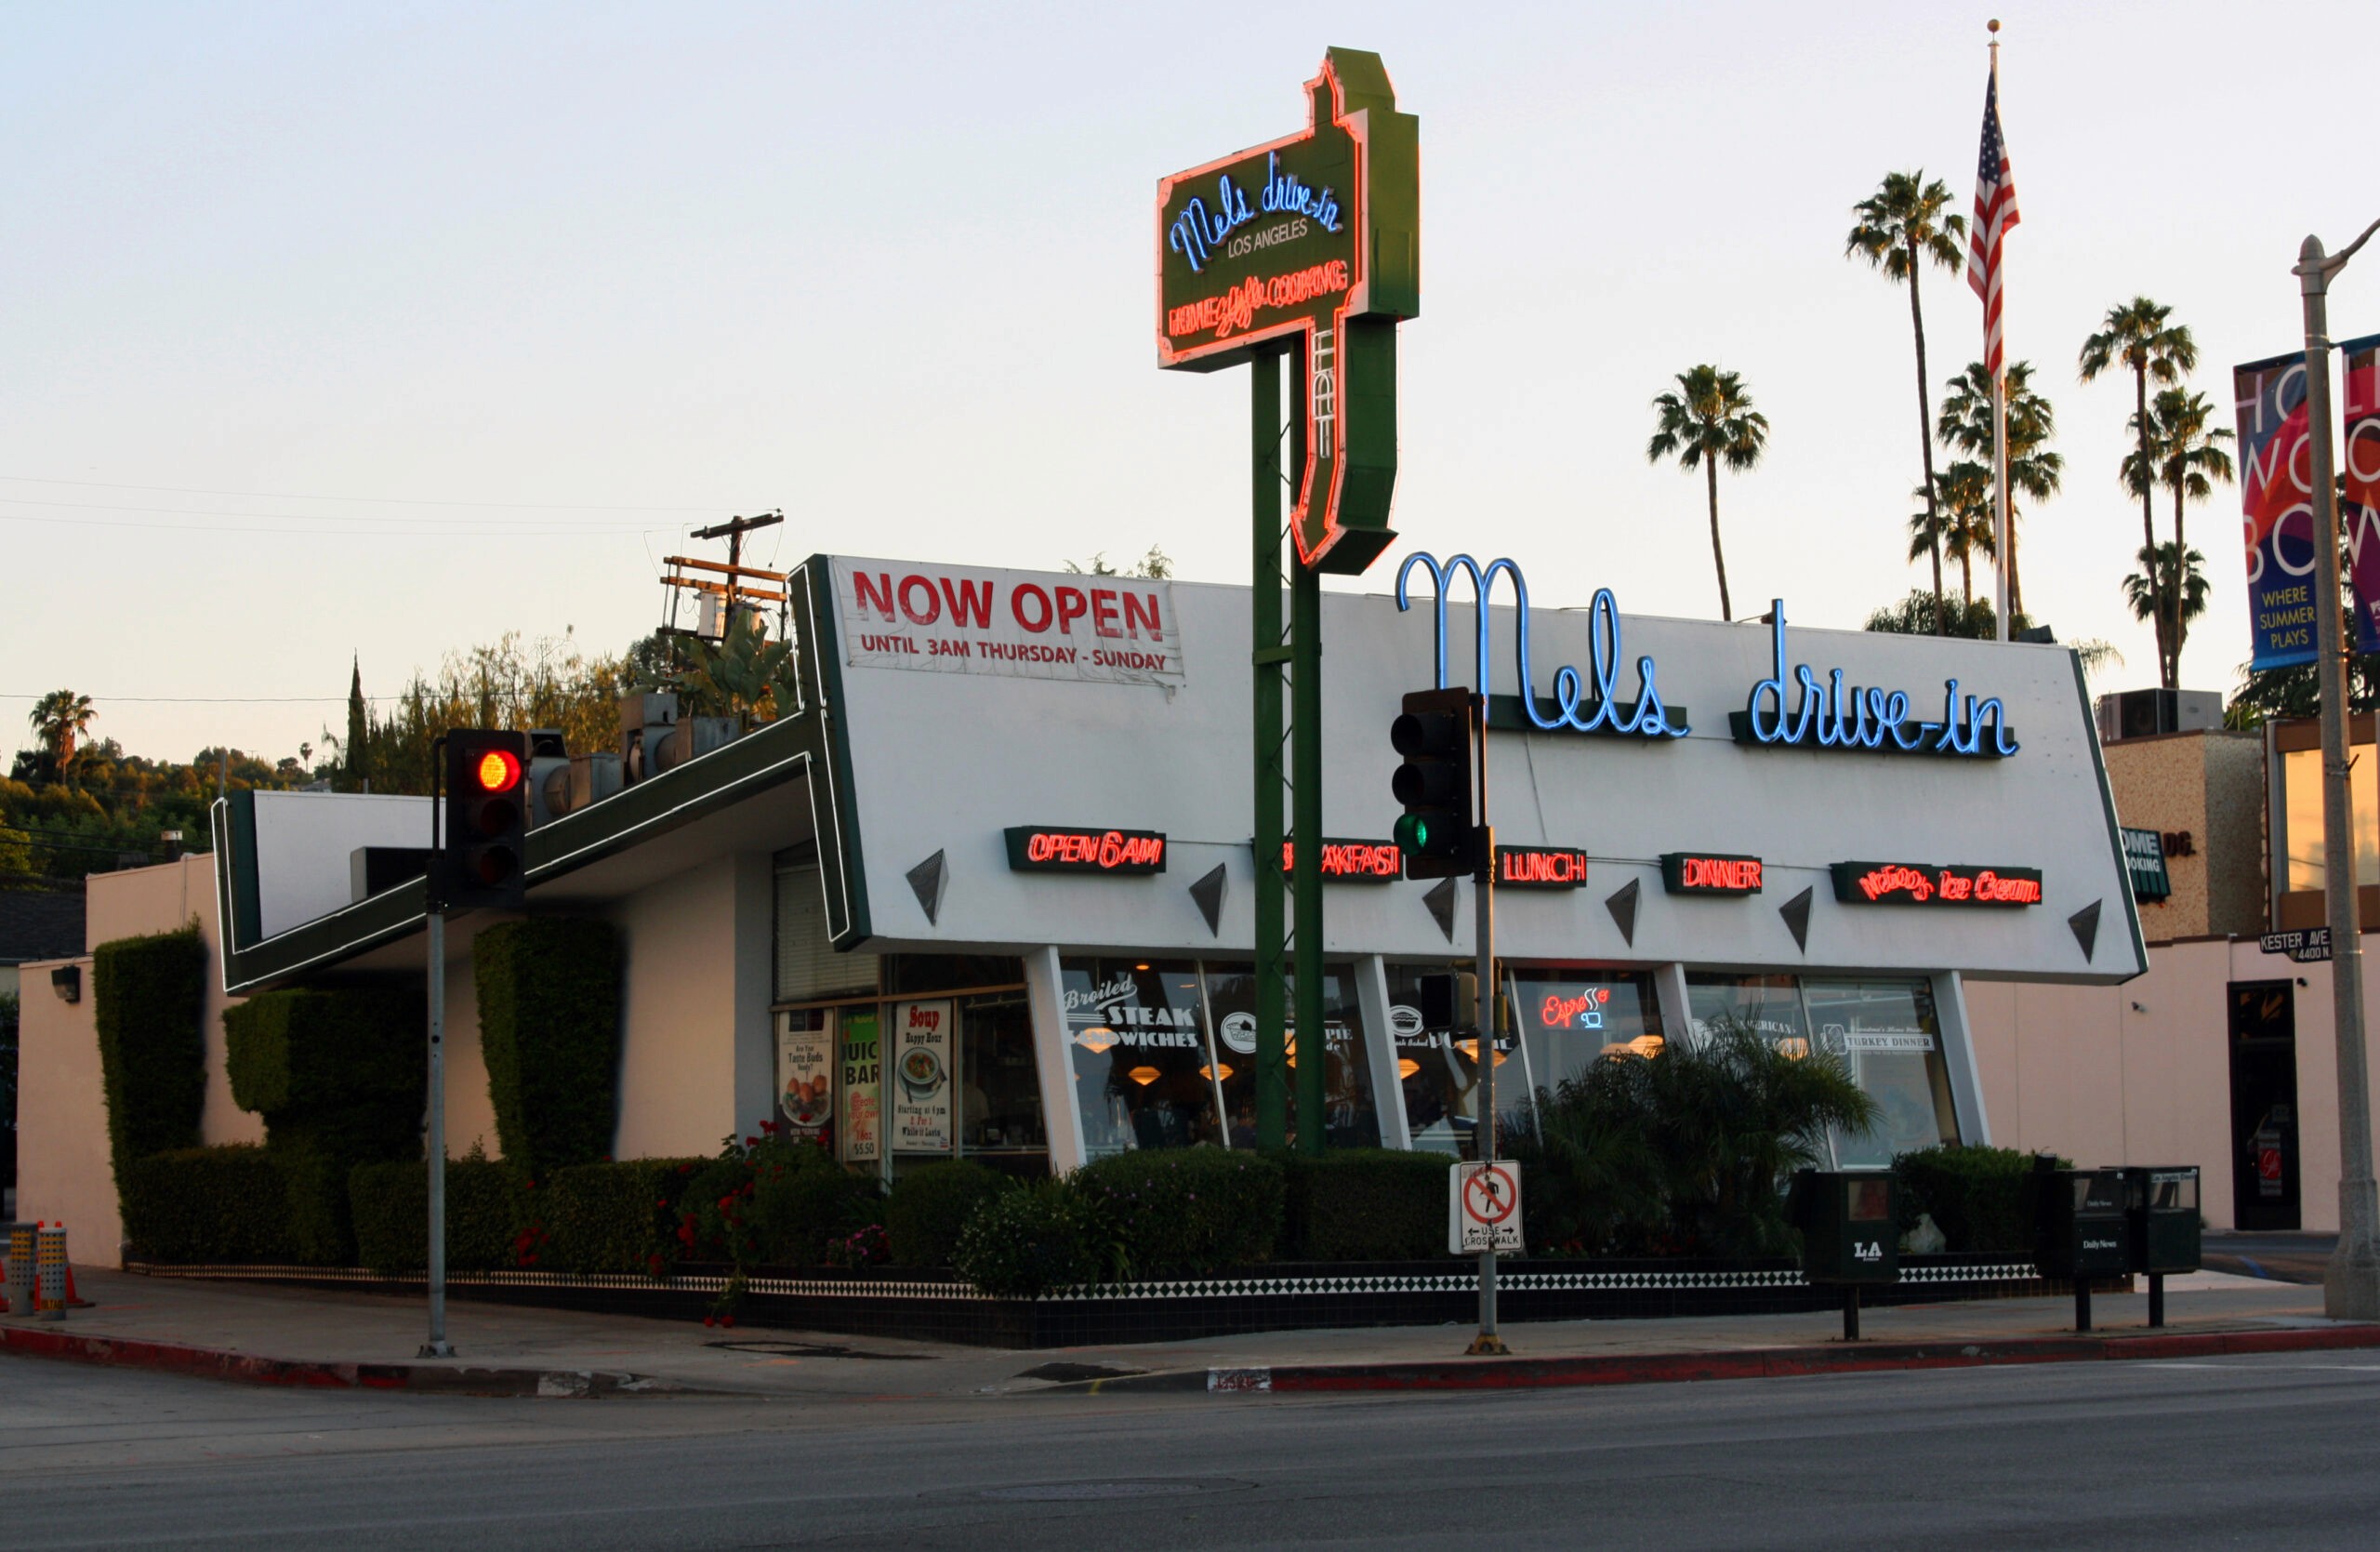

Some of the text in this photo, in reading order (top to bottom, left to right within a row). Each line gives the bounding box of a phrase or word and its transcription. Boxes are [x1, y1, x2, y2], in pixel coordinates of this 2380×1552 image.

[1170, 174, 1256, 273] Mels
[1228, 218, 1309, 259] LOS ANGELES
[1169, 298, 1219, 336] HOME
[1267, 260, 1348, 309] COOKING
[853, 571, 1164, 643] NOW OPEN
[2262, 585, 2308, 607] WHERE
[2259, 606, 2316, 630] SUMMER
[2270, 628, 2309, 650] PLAYS
[861, 633, 919, 655] UNTIL
[927, 638, 971, 658] 3AM
[976, 641, 1078, 665] THURSDAY
[1092, 648, 1167, 671] SUNDAY
[1396, 550, 2019, 757] Mels drive-in
[1027, 830, 1163, 869] OPEN 6AM
[2120, 829, 2160, 856] OME
[1503, 852, 1586, 882] LUNCH
[1683, 857, 1763, 889] DINNER
[1938, 869, 1972, 900] Ice
[1974, 869, 2040, 902] Cream
[2260, 930, 2331, 951] KESTER AVE.
[2298, 947, 2321, 960] 4400
[1063, 973, 1138, 1012] Broiled
[909, 1005, 940, 1032] Soup
[1107, 1005, 1196, 1028] STEAK
[906, 1032, 943, 1045] Happy Hour
[1068, 1029, 1199, 1048] SANDWICHES
[1325, 1028, 1354, 1041] PIE
[1847, 1037, 1931, 1047] TURKEY DINNER
[788, 1051, 824, 1064] Taste Buds
[846, 1064, 879, 1086] BAR
[1481, 1226, 1501, 1236] USE
[1854, 1241, 1883, 1258] LA
[2082, 1239, 2118, 1251] Daily News
